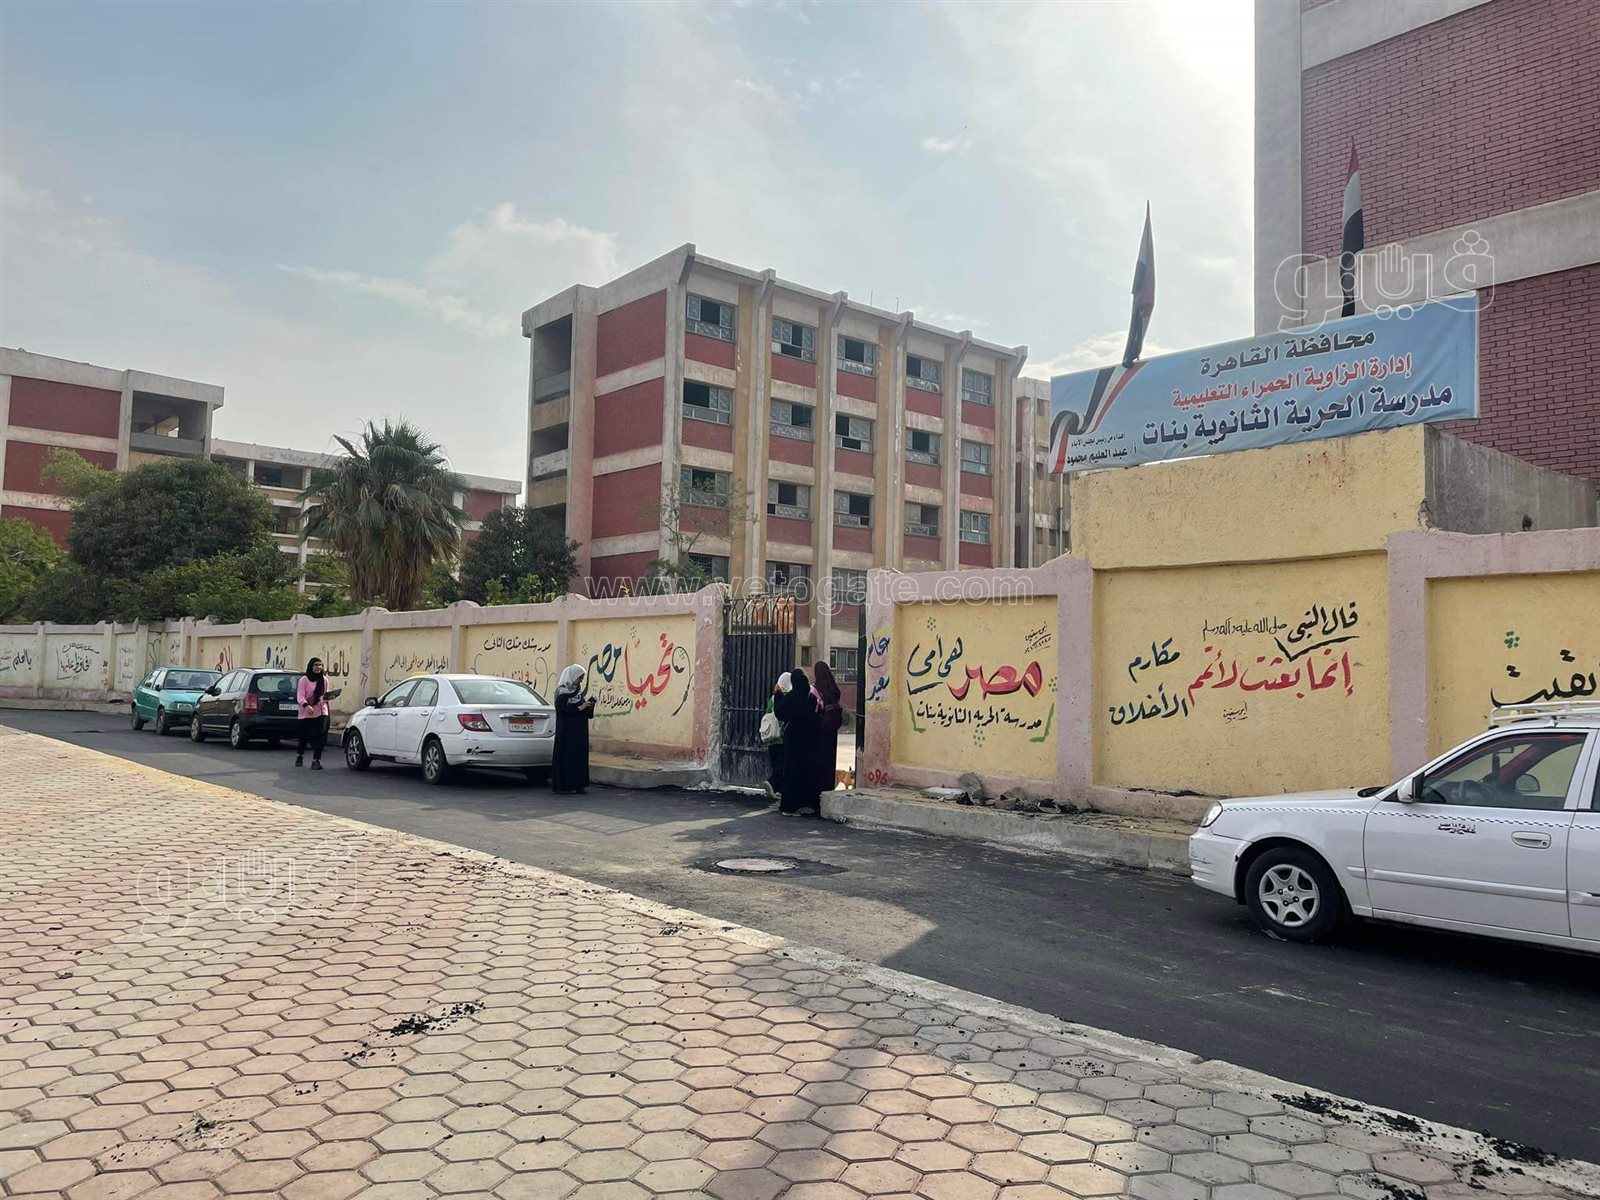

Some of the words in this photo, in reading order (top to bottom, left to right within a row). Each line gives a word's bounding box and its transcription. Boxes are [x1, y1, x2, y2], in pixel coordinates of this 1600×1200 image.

[1285, 331, 1375, 358] محافظة
[1200, 345, 1279, 378] القاهرة
[1304, 361, 1366, 391] الزاوية
[1369, 352, 1412, 379] إدارة
[1172, 383, 1238, 410] التعليمية
[1241, 372, 1300, 399] الحمراء
[1369, 384, 1453, 416] مدرسة
[1192, 403, 1279, 446] الثانوية
[1283, 391, 1364, 433] الحرية
[1142, 420, 1188, 448] بنات
[1066, 454, 1088, 467] محمود
[1112, 448, 1128, 459] عبد
[1236, 619, 1253, 636] عليه
[1252, 616, 1268, 634] الله
[1323, 601, 1358, 636] قال
[580, 643, 622, 698] مصر
[624, 632, 674, 710] تحيا
[1127, 637, 1181, 683] مكارم
[1306, 648, 1354, 697] إنما
[946, 660, 1043, 701] مصر
[1239, 655, 1302, 699] بعثت
[916, 700, 936, 724] بنات
[1001, 707, 1042, 730] مدرسة
[1108, 682, 1189, 726] الأخلاق
